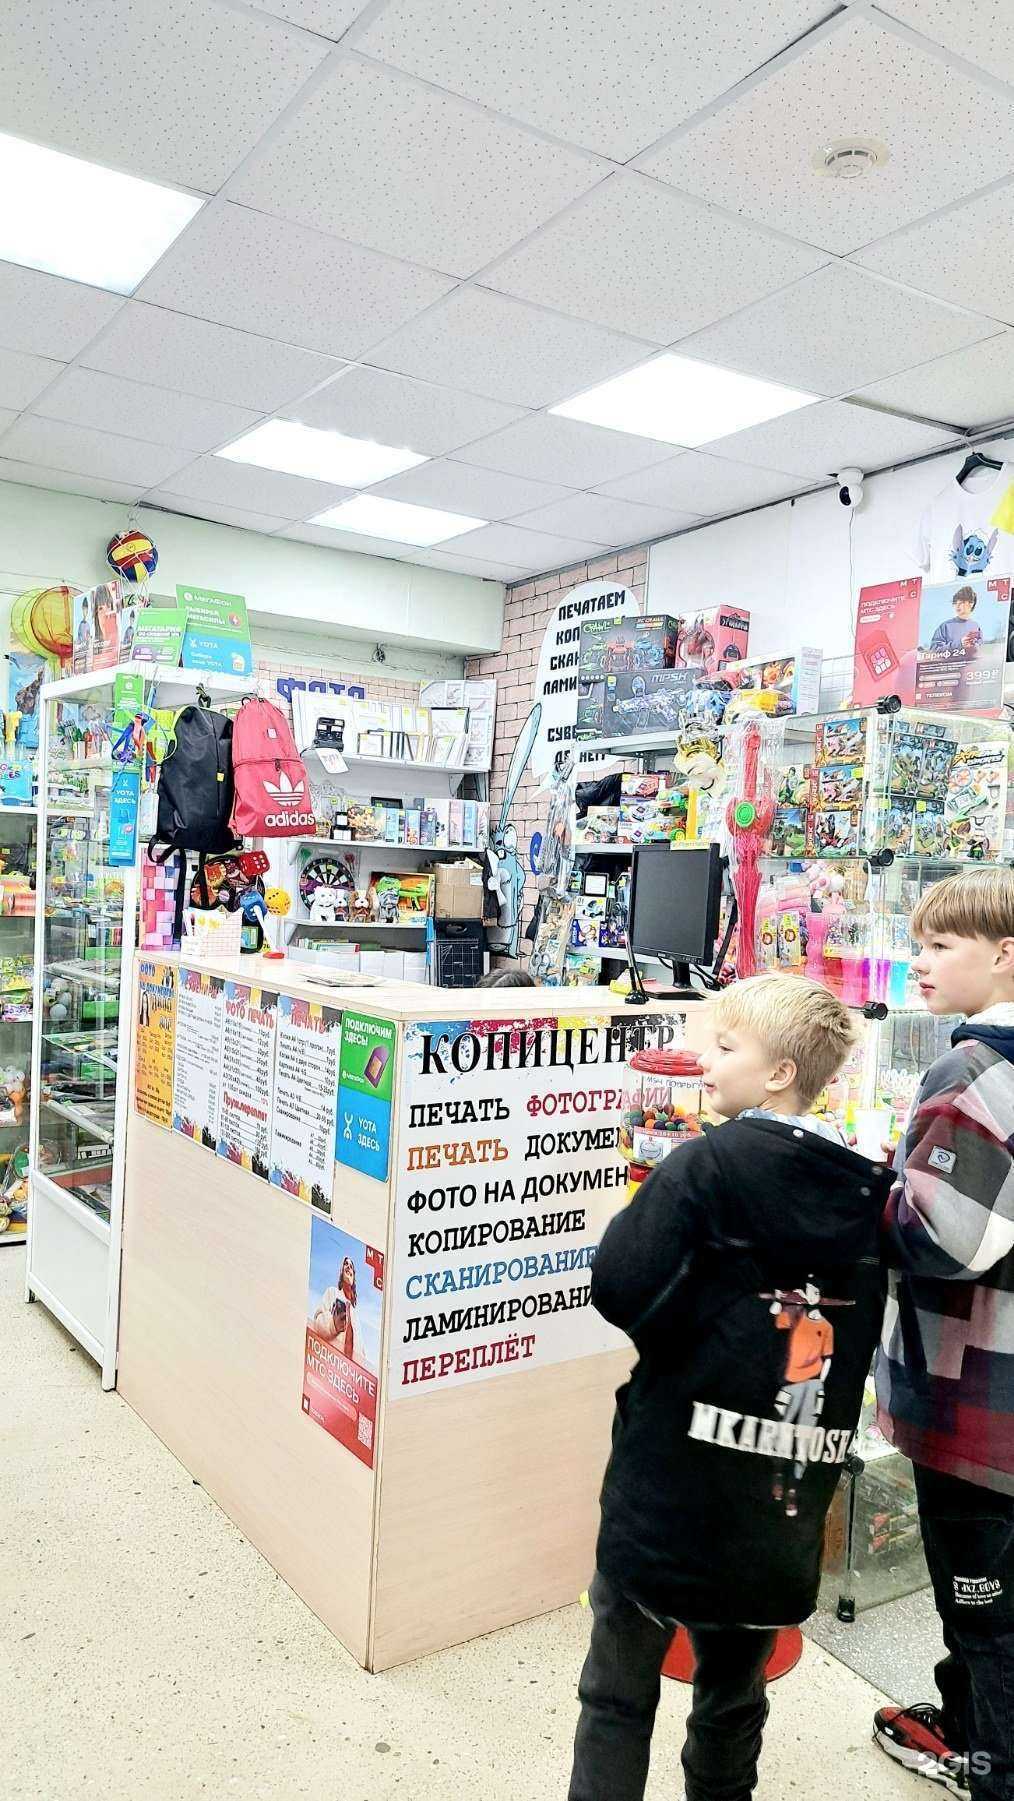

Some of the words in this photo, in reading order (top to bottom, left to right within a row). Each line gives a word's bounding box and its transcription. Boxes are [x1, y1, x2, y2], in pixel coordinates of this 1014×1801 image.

[558, 590, 626, 621] ПЕЧАТАЕМ
[556, 626, 580, 646] КОП
[952, 648, 966, 657] 24
[543, 675, 577, 695] ЛАМИ
[966, 672, 991, 681] 399
[547, 725, 577, 742] СУВЕ
[264, 811, 316, 828] adidas
[226, 1000, 245, 1019] ФОТО
[345, 1018, 393, 1040] ПОДКЛЮЧИМ
[418, 1023, 675, 1076] КОПИЦЕНТР
[358, 1117, 377, 1134] YOTA
[408, 1098, 511, 1129] ПЕЧАТЬ
[357, 1134, 380, 1151] ЗДЕСЬ
[406, 1138, 509, 1171] ПЕЧАТЬ
[407, 1184, 477, 1215] ФОТО
[484, 1180, 516, 1205] НА
[521, 1165, 629, 1204] ДОКУМЕН
[408, 1209, 586, 1257] КОПИРОВАНИЕ
[406, 1243, 600, 1300] СКАНИРОВАНИЕ
[403, 1285, 593, 1343] ЛАМИНИРОВАНИ
[307, 1335, 376, 1397] ПОДКЛЮЧИТЕ
[401, 1333, 536, 1385] ПЕРЕПЛЁТ
[306, 1353, 326, 1377] МТС
[327, 1369, 360, 1404] ЗДЕСЬ
